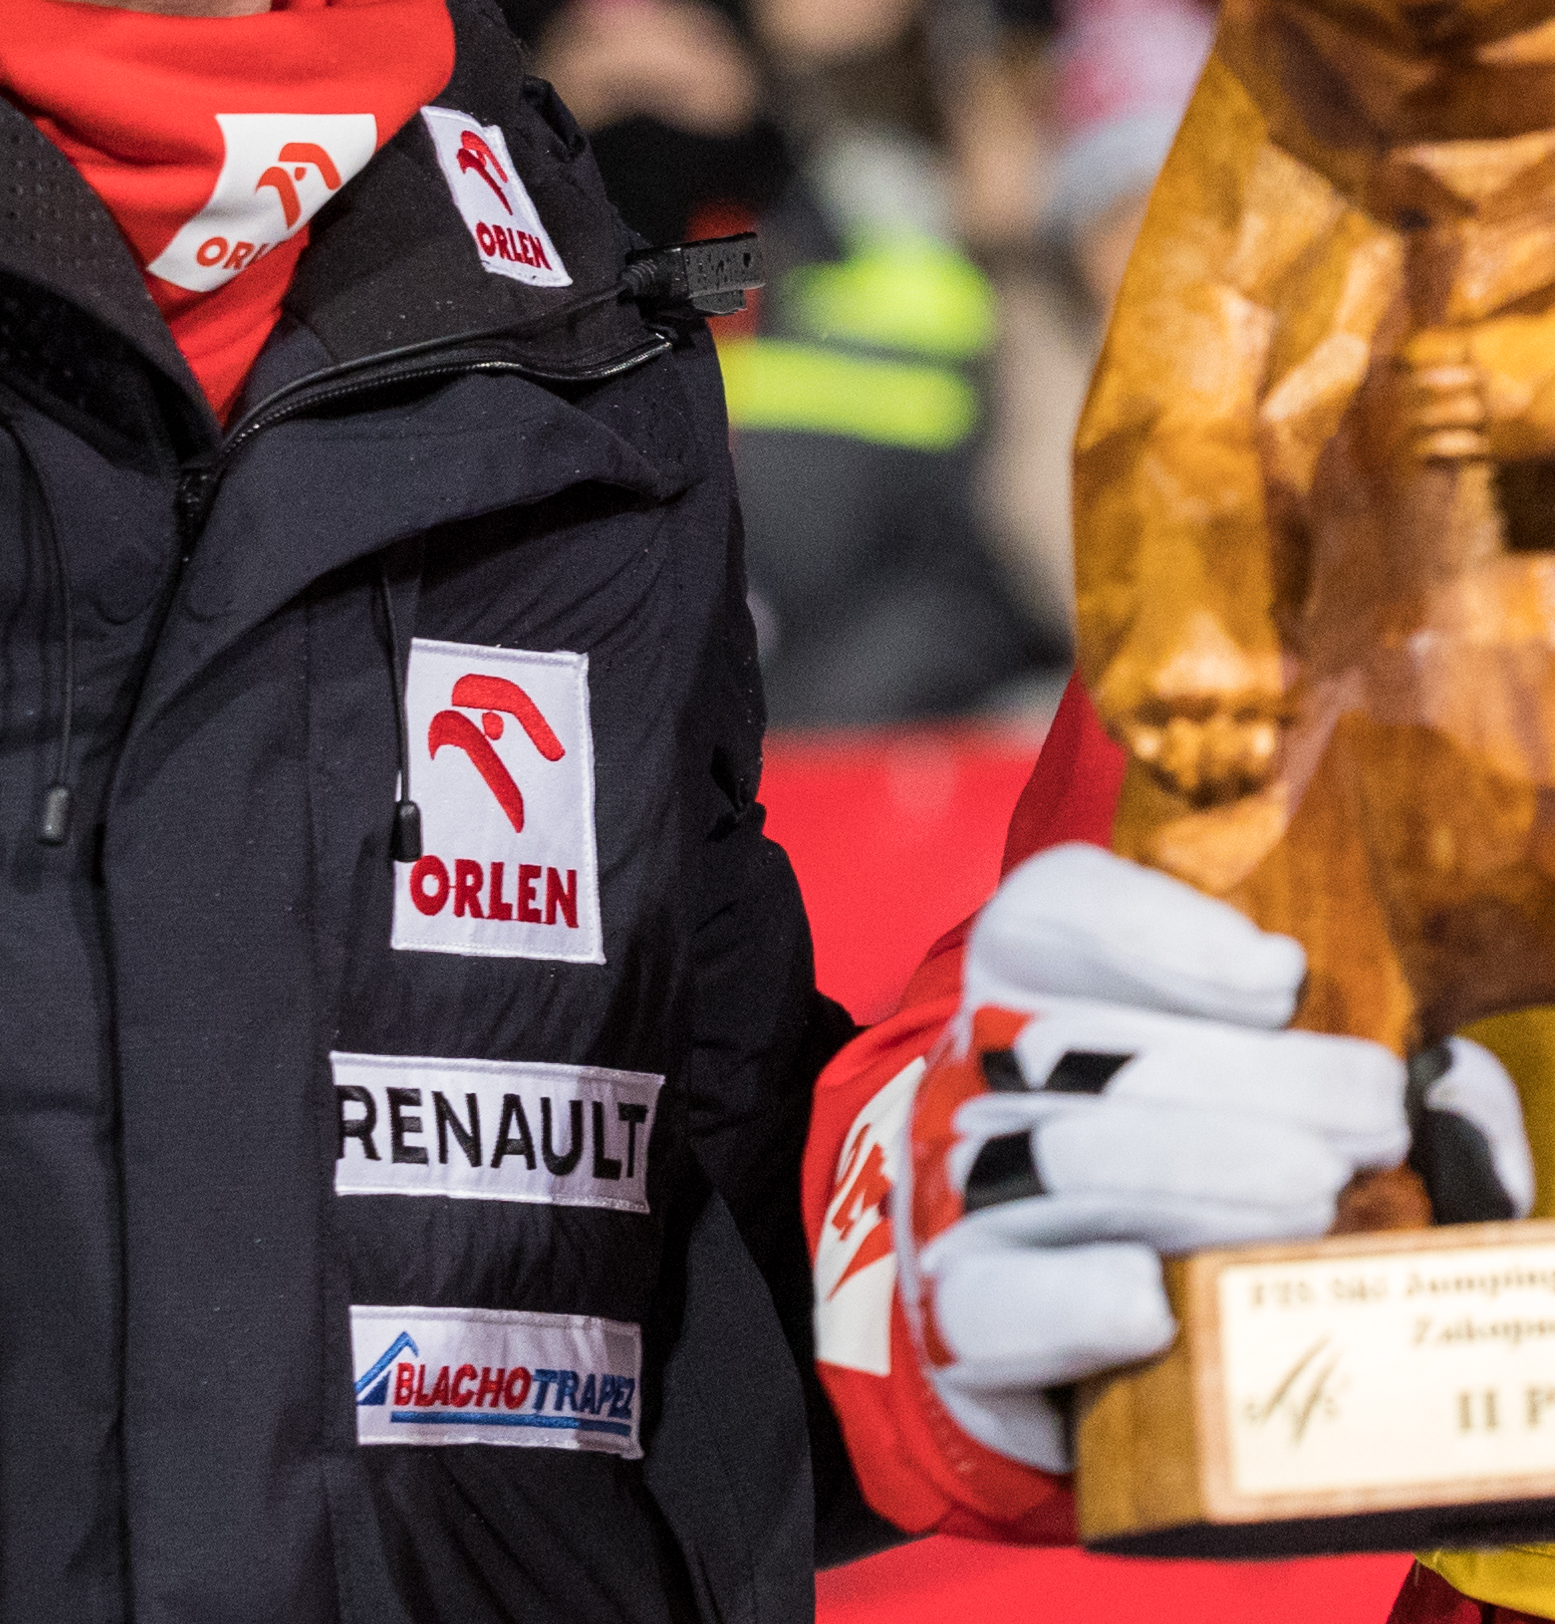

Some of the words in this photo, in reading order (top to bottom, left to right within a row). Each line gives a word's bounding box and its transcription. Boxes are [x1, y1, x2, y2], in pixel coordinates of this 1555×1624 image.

[475, 220, 552, 271] ORLEN
[409, 855, 579, 928] ORLEN
[335, 1084, 648, 1180] RENAULT
[393, 1361, 636, 1420] BLACHOTRAPEZ
